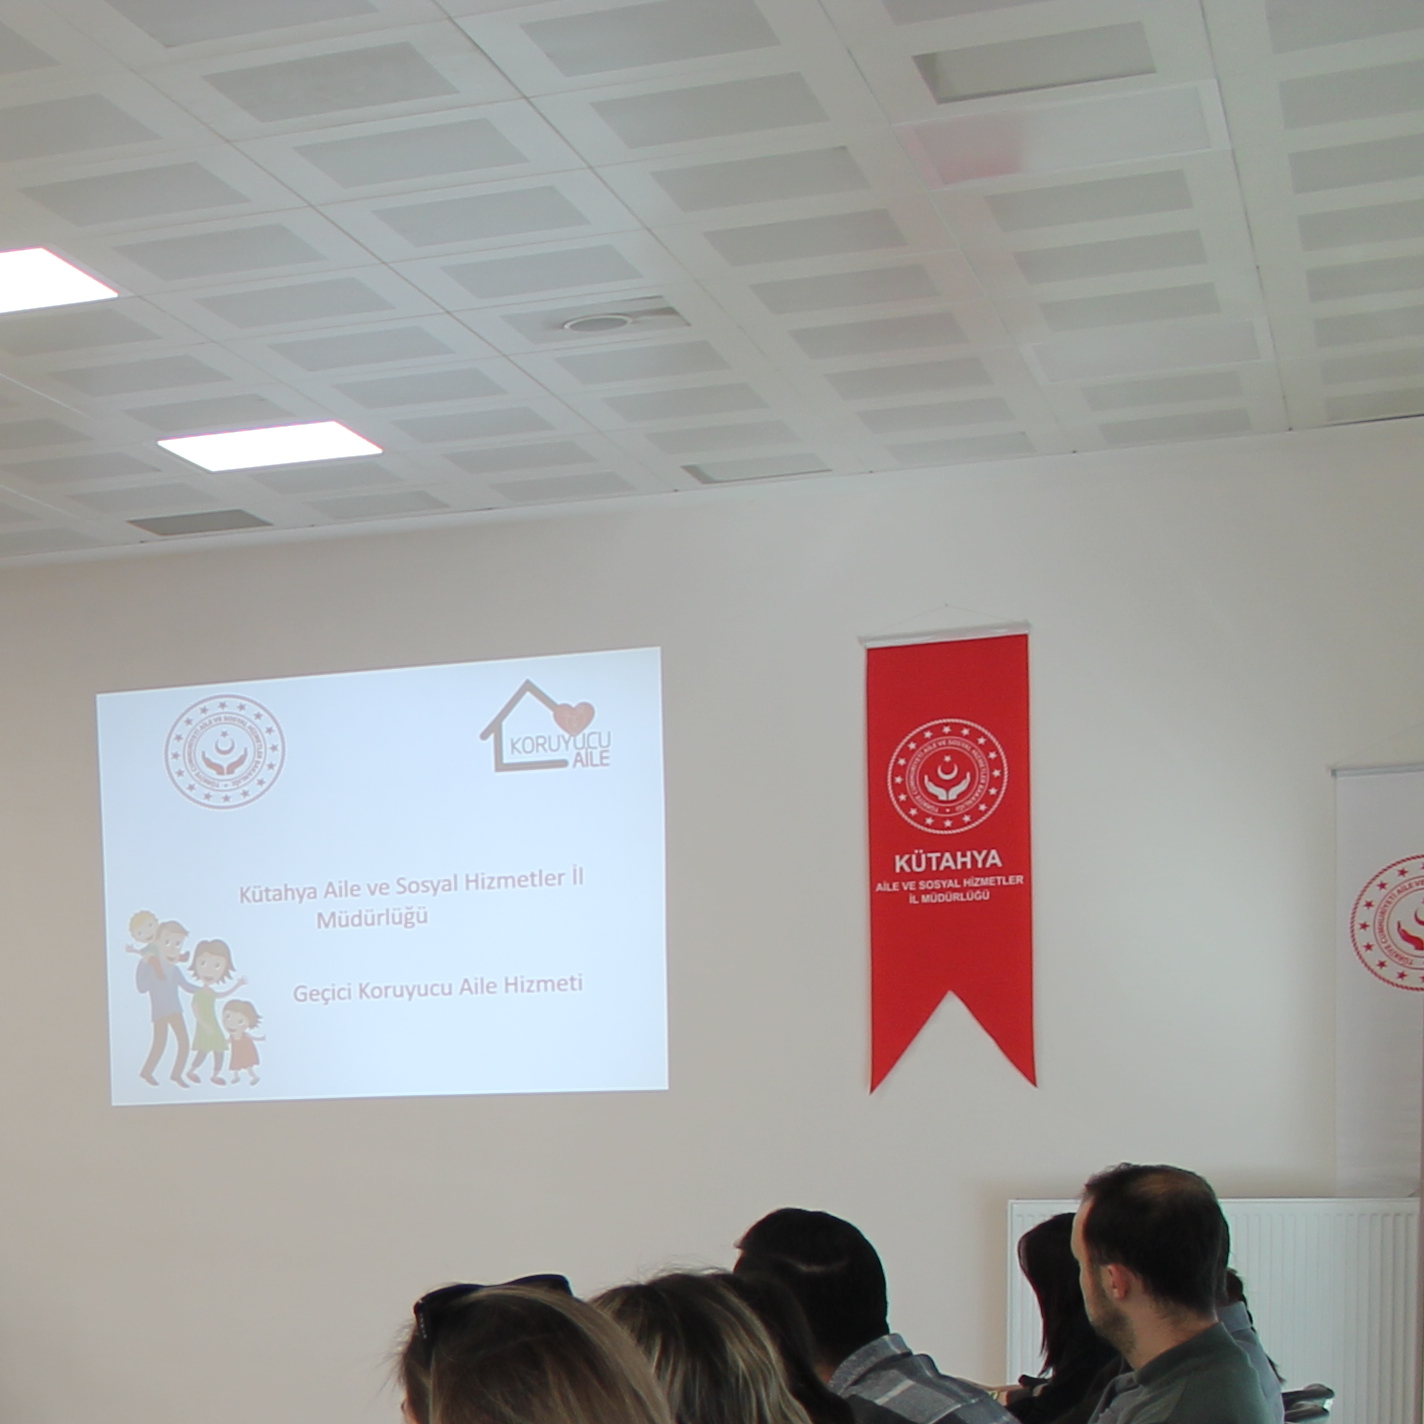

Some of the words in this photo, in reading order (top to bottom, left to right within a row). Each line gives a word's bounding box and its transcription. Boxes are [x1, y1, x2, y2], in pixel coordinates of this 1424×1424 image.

[510, 731, 611, 755] KORUYUCU
[895, 849, 1003, 874] KÜTAHYA
[239, 883, 318, 905] Kütahya
[323, 880, 361, 899] Aile
[366, 881, 391, 897] ve
[396, 873, 458, 898] Sosyal
[465, 868, 566, 891] Hizmetler
[572, 864, 584, 886] İl
[875, 880, 899, 892] AİLE
[902, 880, 916, 891] VE
[918, 879, 961, 891] SOSYAL
[963, 875, 1024, 888] HİZMETLER
[921, 890, 990, 904] MÜDÜRLÜĞÜ
[316, 905, 428, 929] Müdürlüğü
[293, 982, 353, 1006] Geçici
[358, 981, 453, 1001] Koruyucu
[458, 976, 498, 996] Aile
[504, 972, 584, 994] Hizmeti
